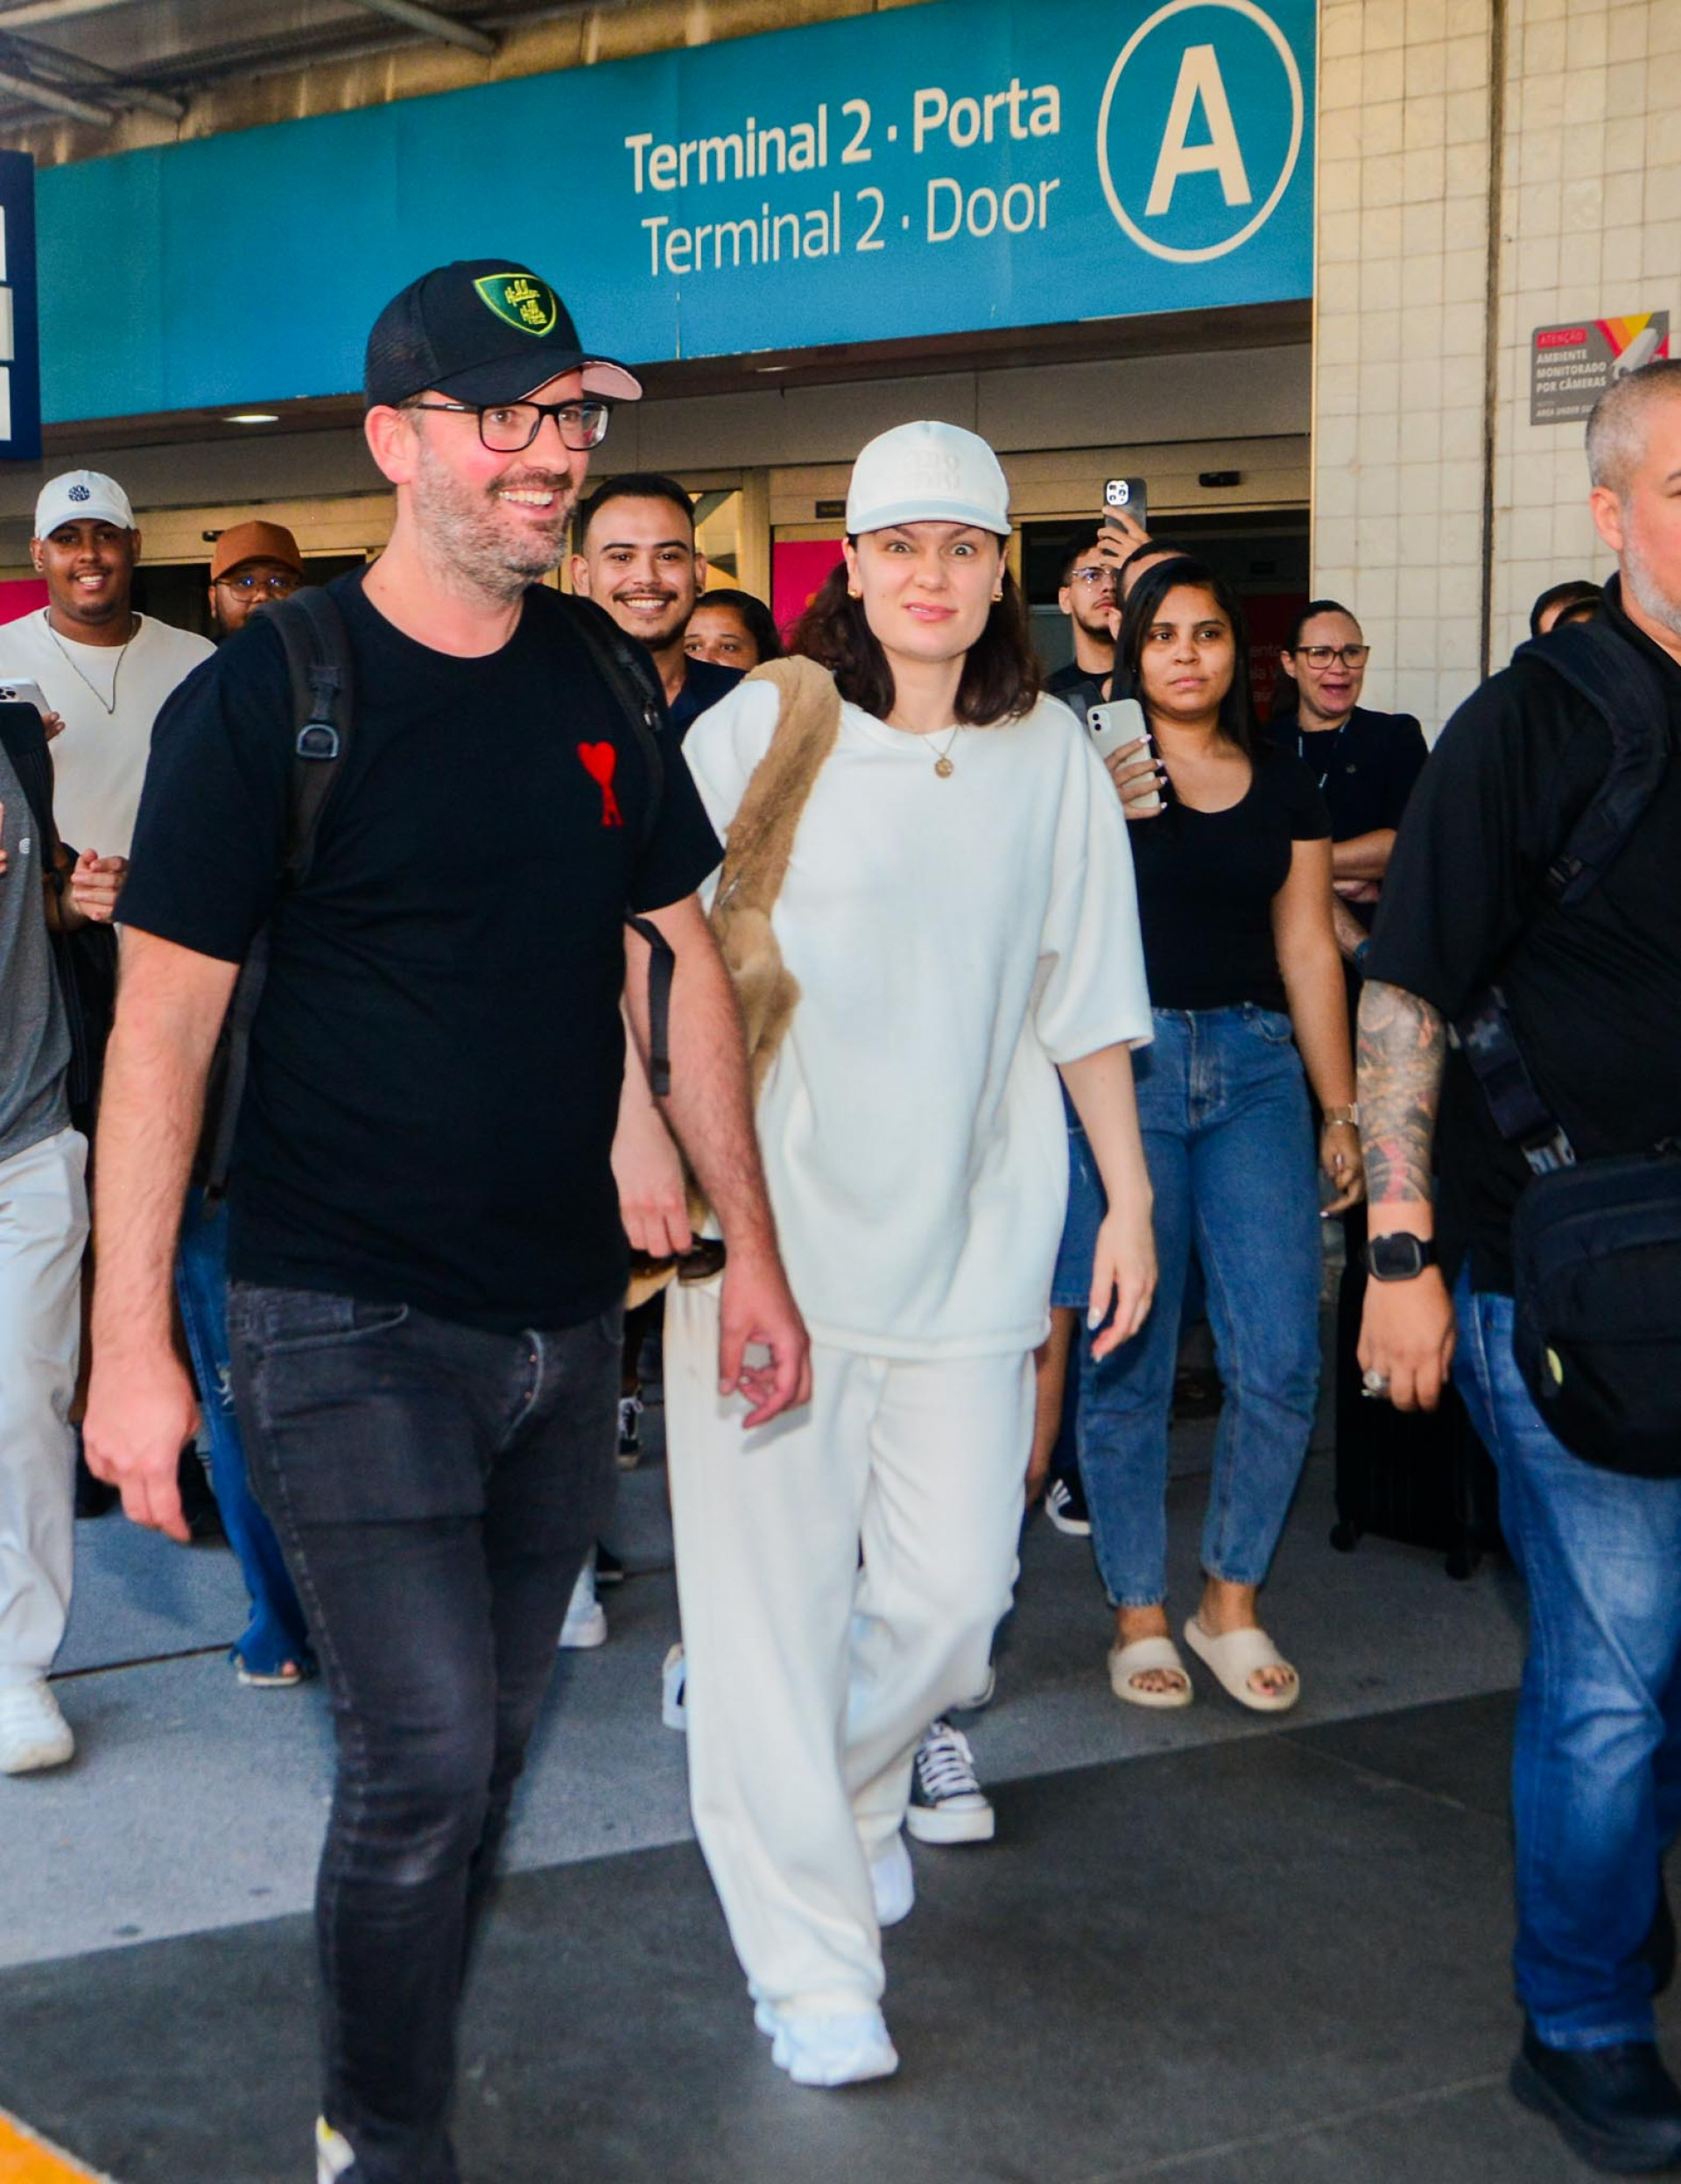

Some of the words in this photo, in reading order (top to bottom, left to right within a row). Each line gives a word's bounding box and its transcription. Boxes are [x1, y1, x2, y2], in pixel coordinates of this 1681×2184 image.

[625, 104, 827, 193] Terminal
[841, 99, 872, 163] 2
[914, 78, 1060, 153] Porta
[1145, 44, 1252, 216] A
[641, 191, 840, 276] Terminal
[856, 187, 884, 250] 2
[927, 178, 1060, 242] Door
[1536, 381, 1557, 393] POR
[1558, 376, 1607, 391] CÂMERAS
[1537, 349, 1587, 364] AMBIENTE
[1537, 362, 1607, 378] MONITORADO
